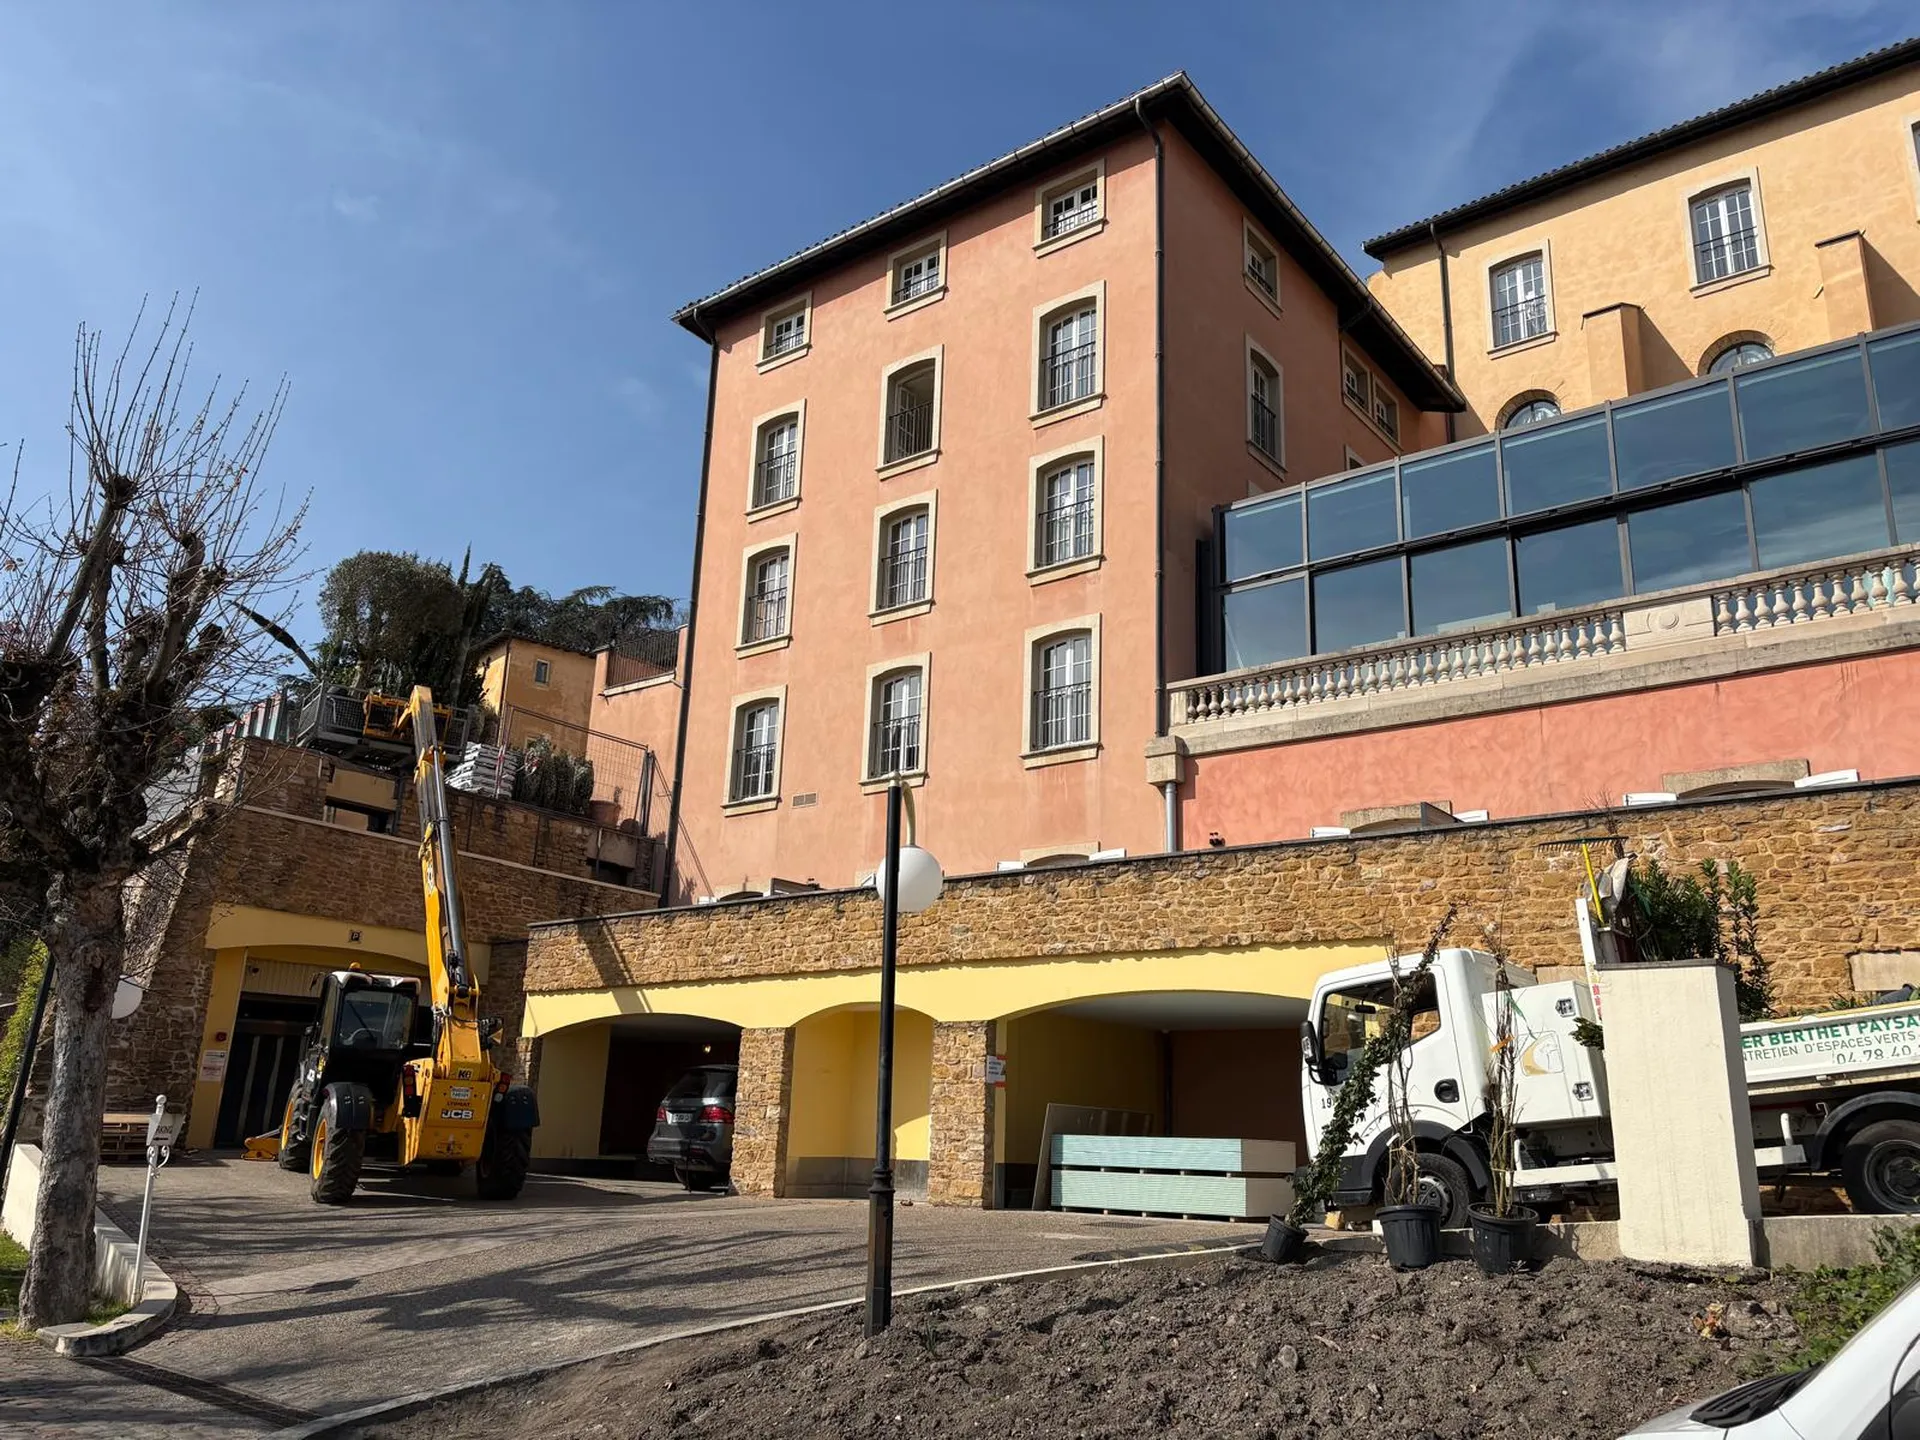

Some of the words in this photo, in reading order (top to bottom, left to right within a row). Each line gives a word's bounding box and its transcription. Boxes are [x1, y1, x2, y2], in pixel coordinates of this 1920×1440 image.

[1767, 1022, 1851, 1046] BERTHET
[1857, 1013, 1920, 1034] PAYSA
[1804, 1036, 1873, 1054] D'ESPACES
[1873, 1030, 1916, 1045] VERTS
[441, 1110, 474, 1119] JCB
